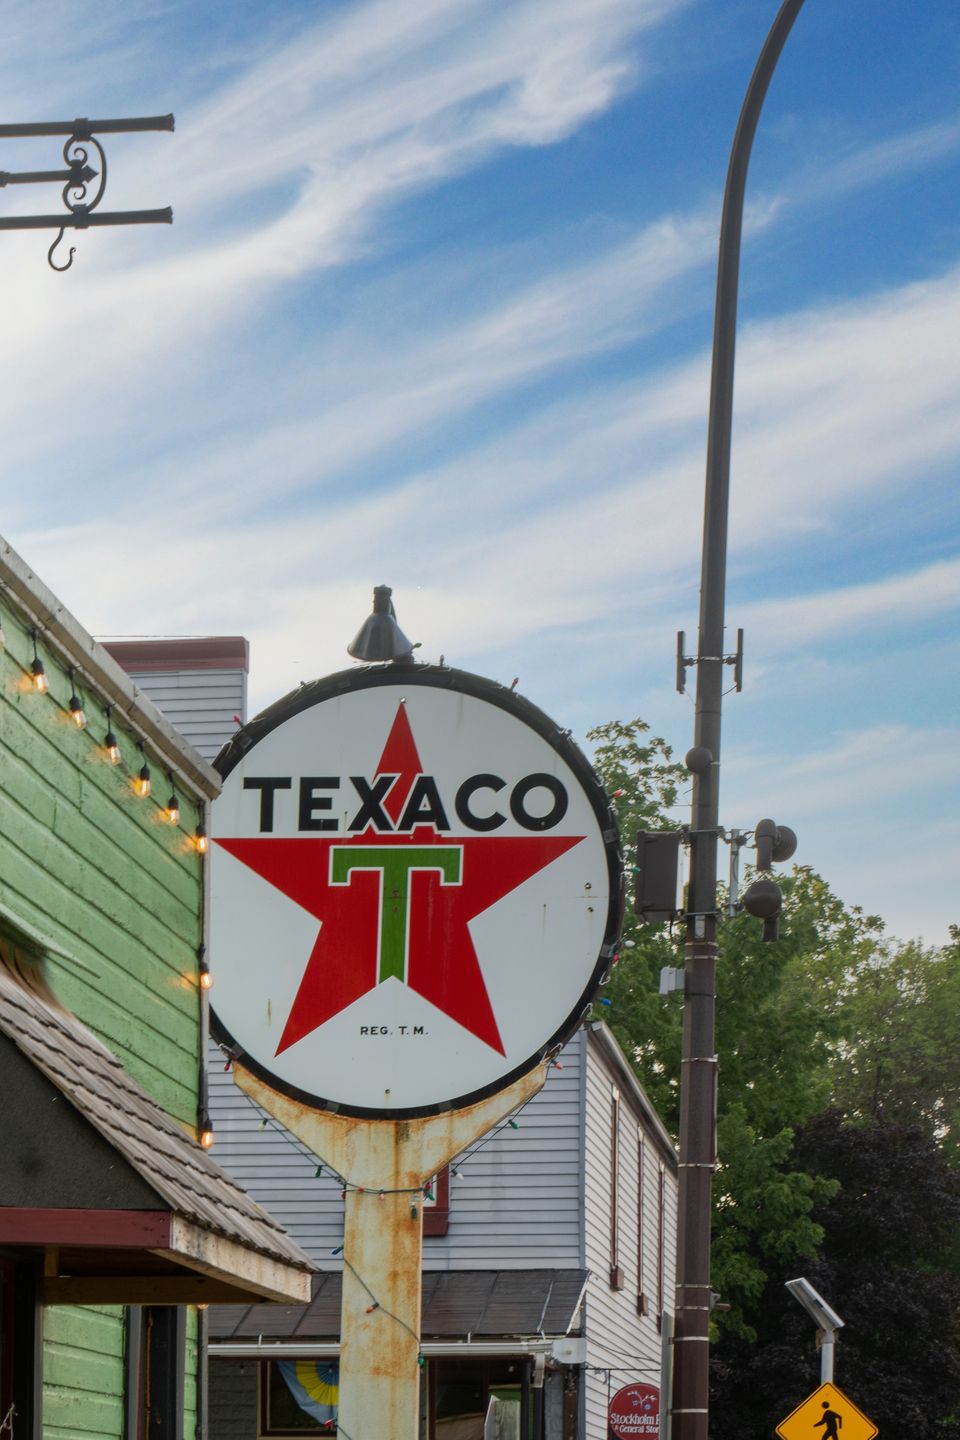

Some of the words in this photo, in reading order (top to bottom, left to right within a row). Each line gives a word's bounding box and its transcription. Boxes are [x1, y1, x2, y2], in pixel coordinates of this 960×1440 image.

[243, 773, 569, 832] TEXACO
[329, 845, 464, 984] T
[360, 1025, 393, 1036] REG.
[610, 1412, 655, 1425] Stockholm
[619, 1424, 645, 1434] General
